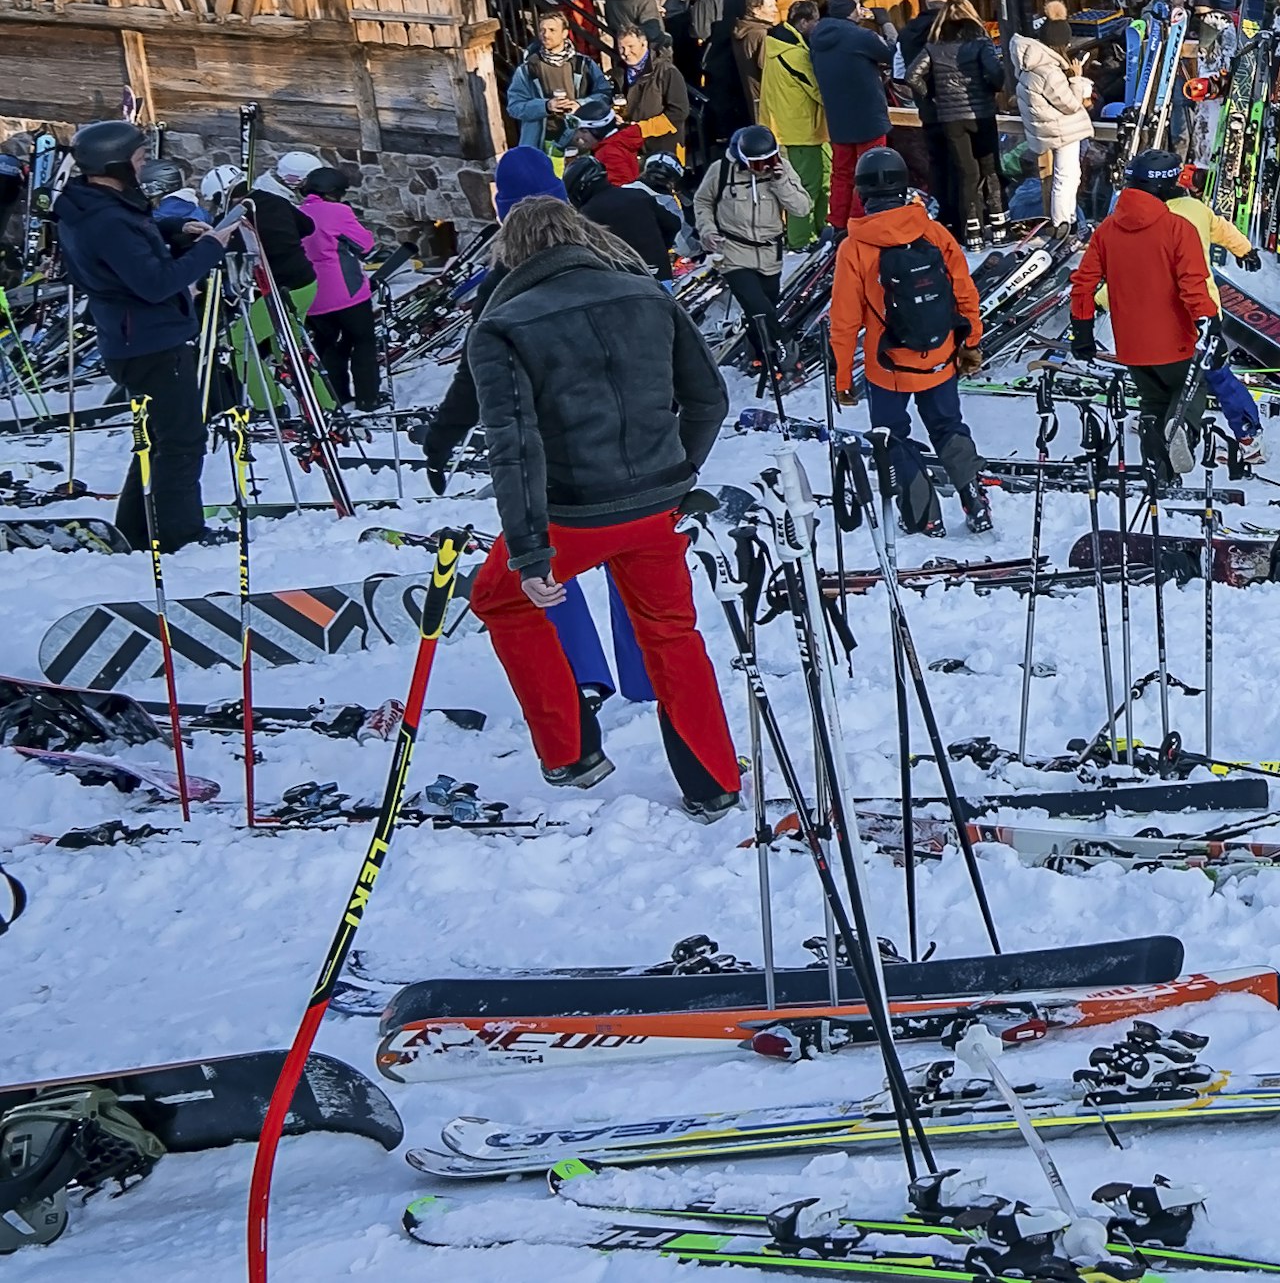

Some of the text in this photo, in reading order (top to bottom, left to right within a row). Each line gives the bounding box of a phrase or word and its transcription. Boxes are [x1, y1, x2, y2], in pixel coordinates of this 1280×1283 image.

[1005, 263, 1039, 293] HEAD
[740, 651, 768, 699] LEKI
[344, 836, 389, 928] LEKI
